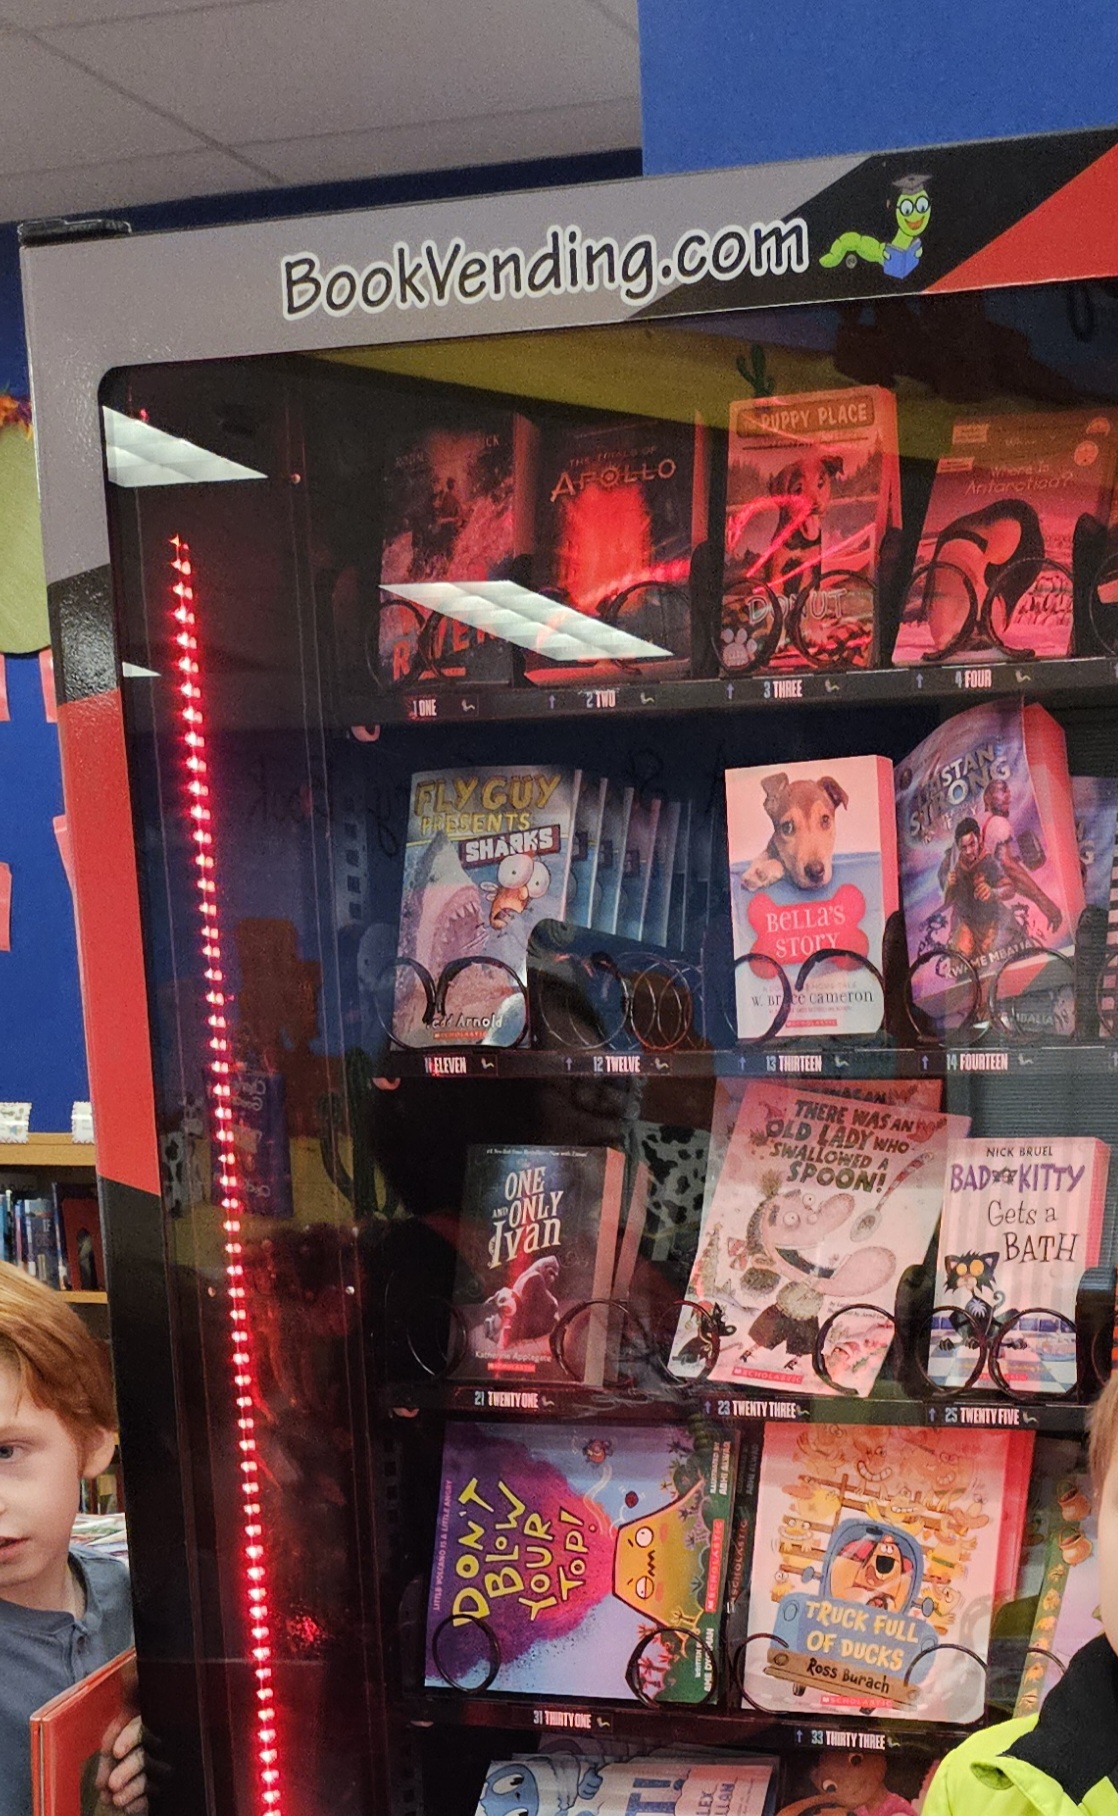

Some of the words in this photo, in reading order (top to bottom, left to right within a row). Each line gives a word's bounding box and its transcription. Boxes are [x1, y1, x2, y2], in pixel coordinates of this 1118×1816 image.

[283, 217, 809, 321] BookVending.com
[761, 408, 810, 431] PUPPY
[817, 402, 867, 425] PLACE
[965, 471, 1073, 496] Antarctica?
[764, 683, 770, 698] 3
[773, 681, 802, 698] THREE
[955, 672, 962, 687] 4
[965, 670, 991, 687] FOUR
[419, 699, 437, 717] ONE
[586, 693, 593, 707] 2
[595, 690, 616, 707] TWO
[414, 776, 478, 816] FLY
[482, 773, 561, 811] GUY
[421, 812, 532, 836] PRESENTS
[466, 827, 553, 862] SHARKS
[768, 993, 805, 1006] Brce
[426, 1013, 453, 1030] edd
[456, 1012, 503, 1028] Arnold
[434, 1057, 467, 1074] ELEVEN
[593, 1057, 603, 1072] 12
[605, 1056, 641, 1073] TWELVE
[766, 1056, 776, 1071] 13
[779, 1055, 822, 1072] THIRTEEN
[946, 1054, 958, 1070] 14
[960, 1053, 1008, 1071] FOURTEEN
[794, 1099, 848, 1125] THERE
[852, 1108, 891, 1130] WAS
[889, 1118, 914, 1132] AN
[766, 1118, 812, 1141] OLD
[817, 1124, 874, 1151] LADY
[874, 1136, 910, 1154] WHO
[769, 1142, 873, 1169] SWALLOWED
[878, 1157, 889, 1171] A
[986, 1147, 1014, 1158] NICK
[1019, 1146, 1053, 1157] BRUEL
[505, 1167, 546, 1201] ONE
[786, 1161, 887, 1193] SPOON!
[950, 1163, 992, 1193] BAD
[1018, 1164, 1086, 1193] KITTY
[492, 1207, 508, 1218] AND
[509, 1191, 564, 1228] ONLY
[988, 1200, 1037, 1227] Gets
[1045, 1206, 1057, 1223] a
[487, 1218, 562, 1270] Ivan
[1003, 1231, 1080, 1264] BATH
[512, 1352, 552, 1362] Applegate
[741, 1370, 802, 1384] SCHOLASTIC
[474, 1390, 485, 1406] 21
[488, 1391, 521, 1408] TWENTY
[521, 1393, 539, 1408] ONE
[718, 1401, 730, 1416] 23
[732, 1400, 767, 1418] TWENTY
[769, 1402, 797, 1419] THREE
[945, 1407, 958, 1423] 25
[960, 1407, 997, 1425] TWENTY
[998, 1408, 1020, 1425] FIVE
[721, 1440, 732, 1472] ALWAR
[444, 1479, 453, 1507] ANGRY
[719, 1474, 728, 1495] ABHI
[442, 1508, 451, 1532] LITTLE
[452, 1476, 495, 1627] DON'T
[707, 1520, 723, 1602] SCHOLASTIC
[436, 1550, 447, 1585] VOLCANO
[518, 1511, 558, 1622] YOUR
[433, 1588, 443, 1611] LITTLE
[805, 1599, 868, 1632] TRUCK
[873, 1612, 920, 1644] FULL
[806, 1630, 838, 1652] OF
[841, 1637, 905, 1672] DUCKS
[806, 1657, 838, 1680] Ross
[842, 1665, 890, 1694] Burach
[831, 1696, 893, 1707] SCHOLASTIC
[533, 1710, 543, 1725] 31
[544, 1710, 574, 1728] THIRTY
[574, 1713, 592, 1729] ONE
[811, 1730, 823, 1745] 33
[825, 1730, 858, 1748] THIRTY
[858, 1733, 886, 1751] THREE
